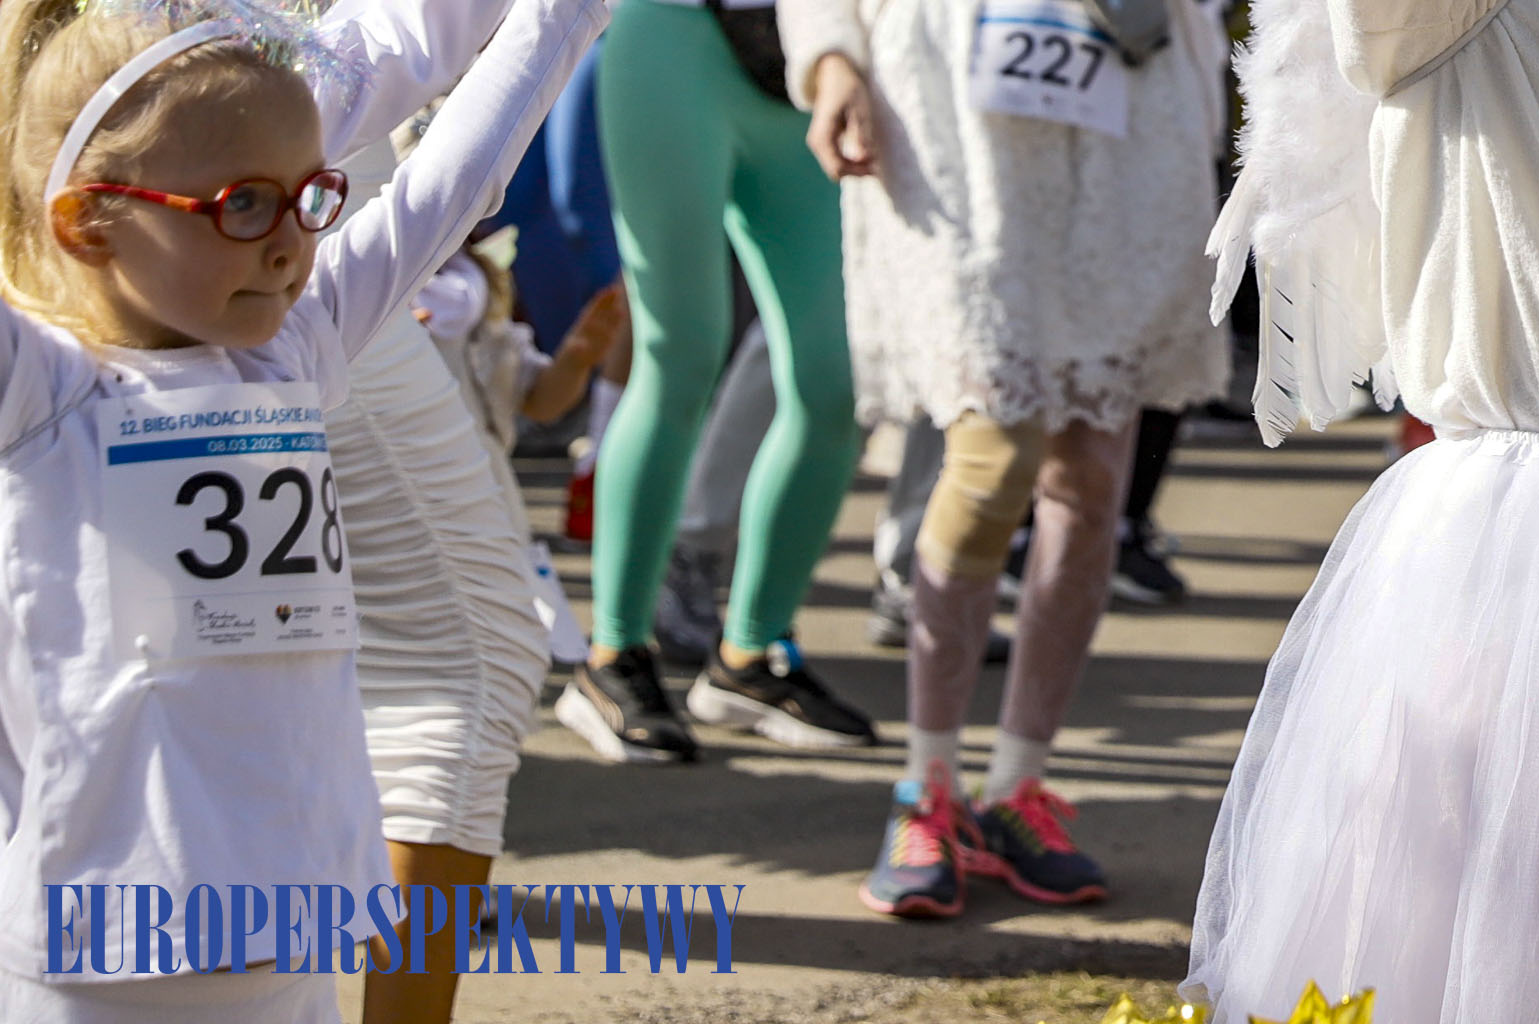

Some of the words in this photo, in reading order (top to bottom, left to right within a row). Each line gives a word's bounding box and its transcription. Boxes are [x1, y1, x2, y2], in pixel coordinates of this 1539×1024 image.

[1001, 31, 1104, 92] 227
[142, 416, 177, 434] BIEG
[179, 408, 252, 430] FUNDACJI
[207, 436, 283, 453] 08.03.2025
[175, 466, 343, 580] 328
